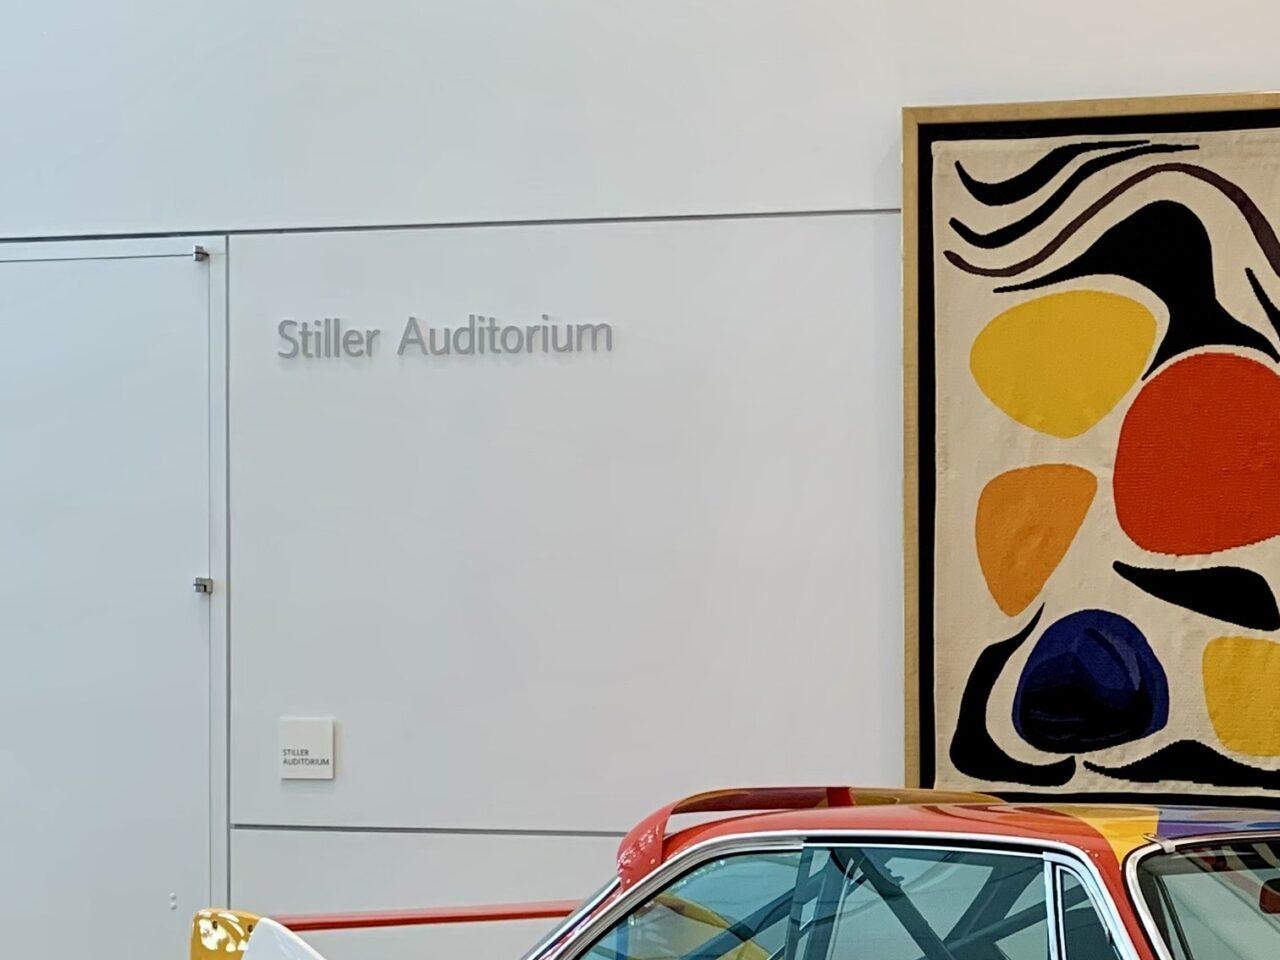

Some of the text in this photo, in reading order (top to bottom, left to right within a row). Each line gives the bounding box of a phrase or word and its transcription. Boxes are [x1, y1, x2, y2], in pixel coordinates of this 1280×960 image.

[278, 314, 613, 359] Stiller Auditorium
[282, 748, 309, 756] STILLER
[282, 758, 330, 766] AUDITORIUM
